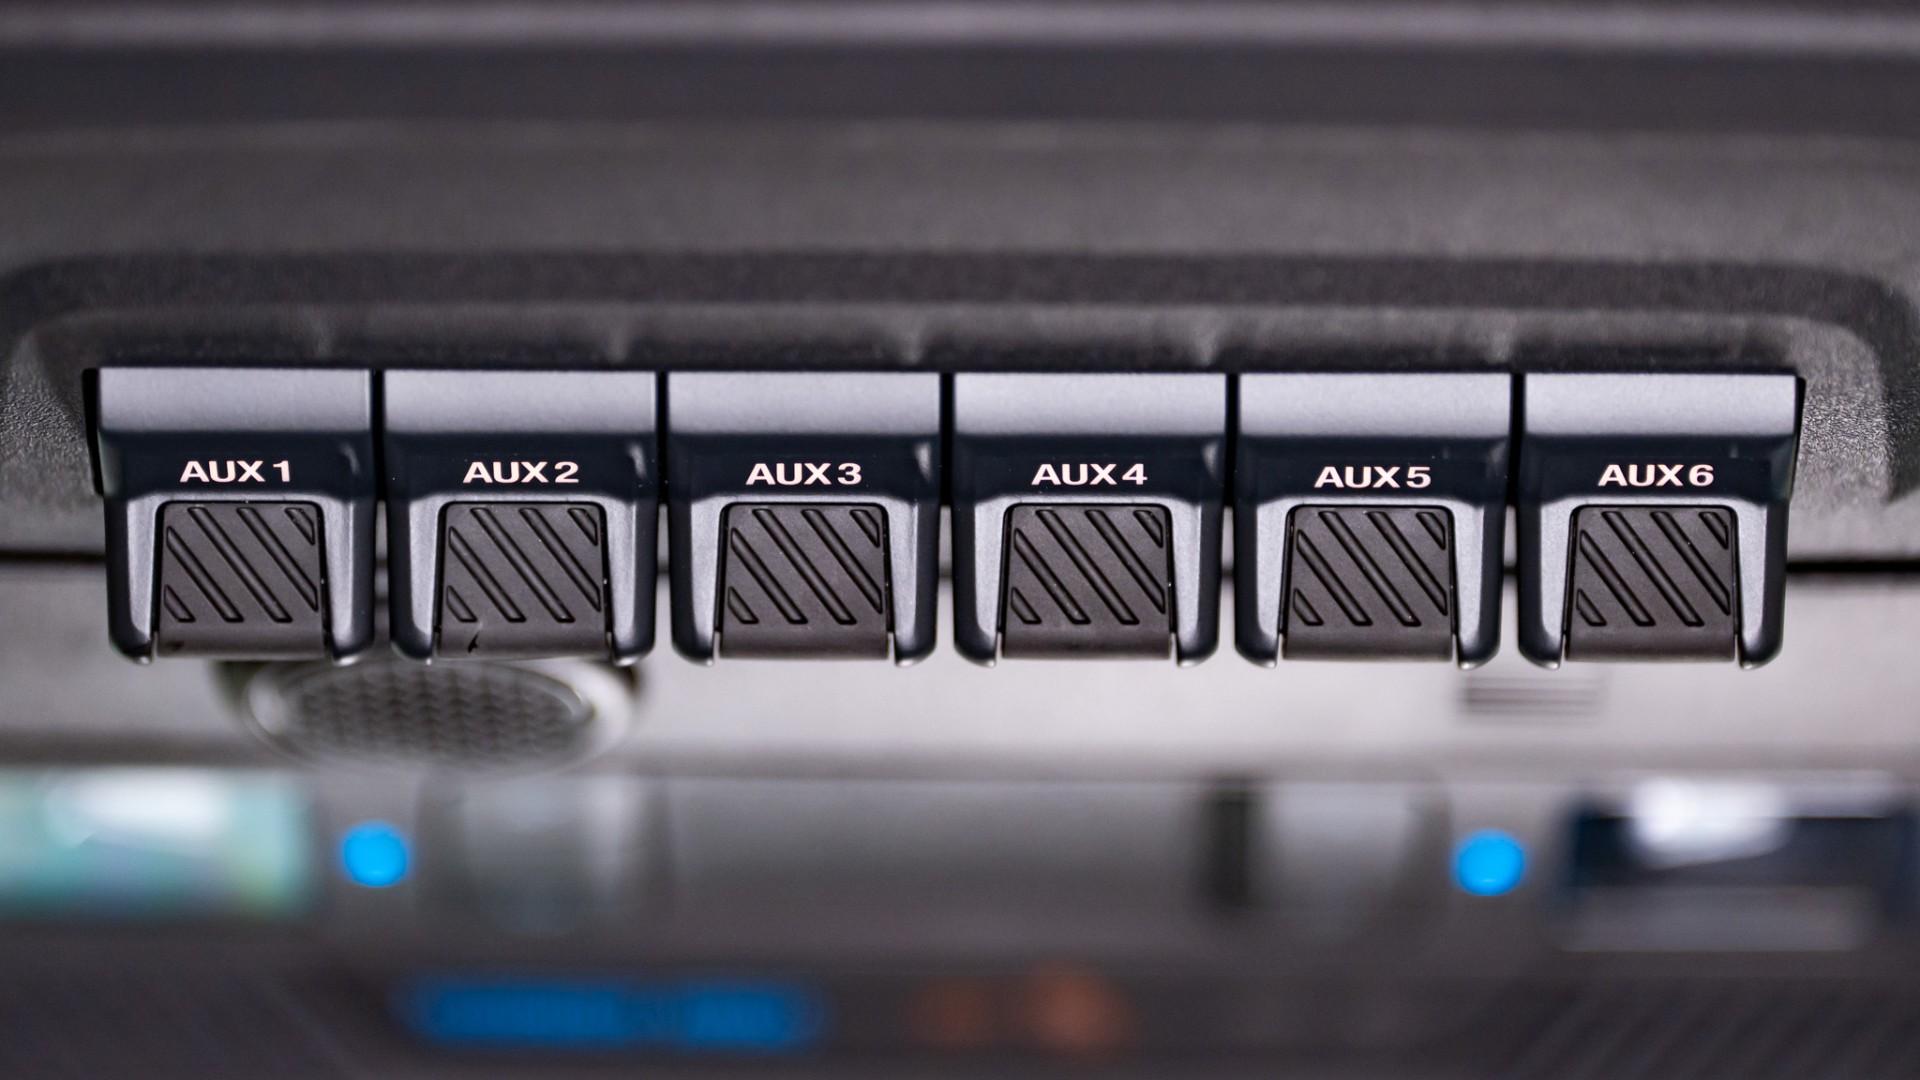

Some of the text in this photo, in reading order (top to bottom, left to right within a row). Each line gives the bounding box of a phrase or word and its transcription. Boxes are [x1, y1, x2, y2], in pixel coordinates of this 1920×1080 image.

[179, 460, 290, 483] AUX 1
[462, 461, 579, 484] AUX 2
[745, 462, 862, 486] AUX 3
[1031, 463, 1148, 486] AUX 4
[1314, 466, 1431, 489] AUX 5
[1597, 464, 1714, 487] AUX 6
